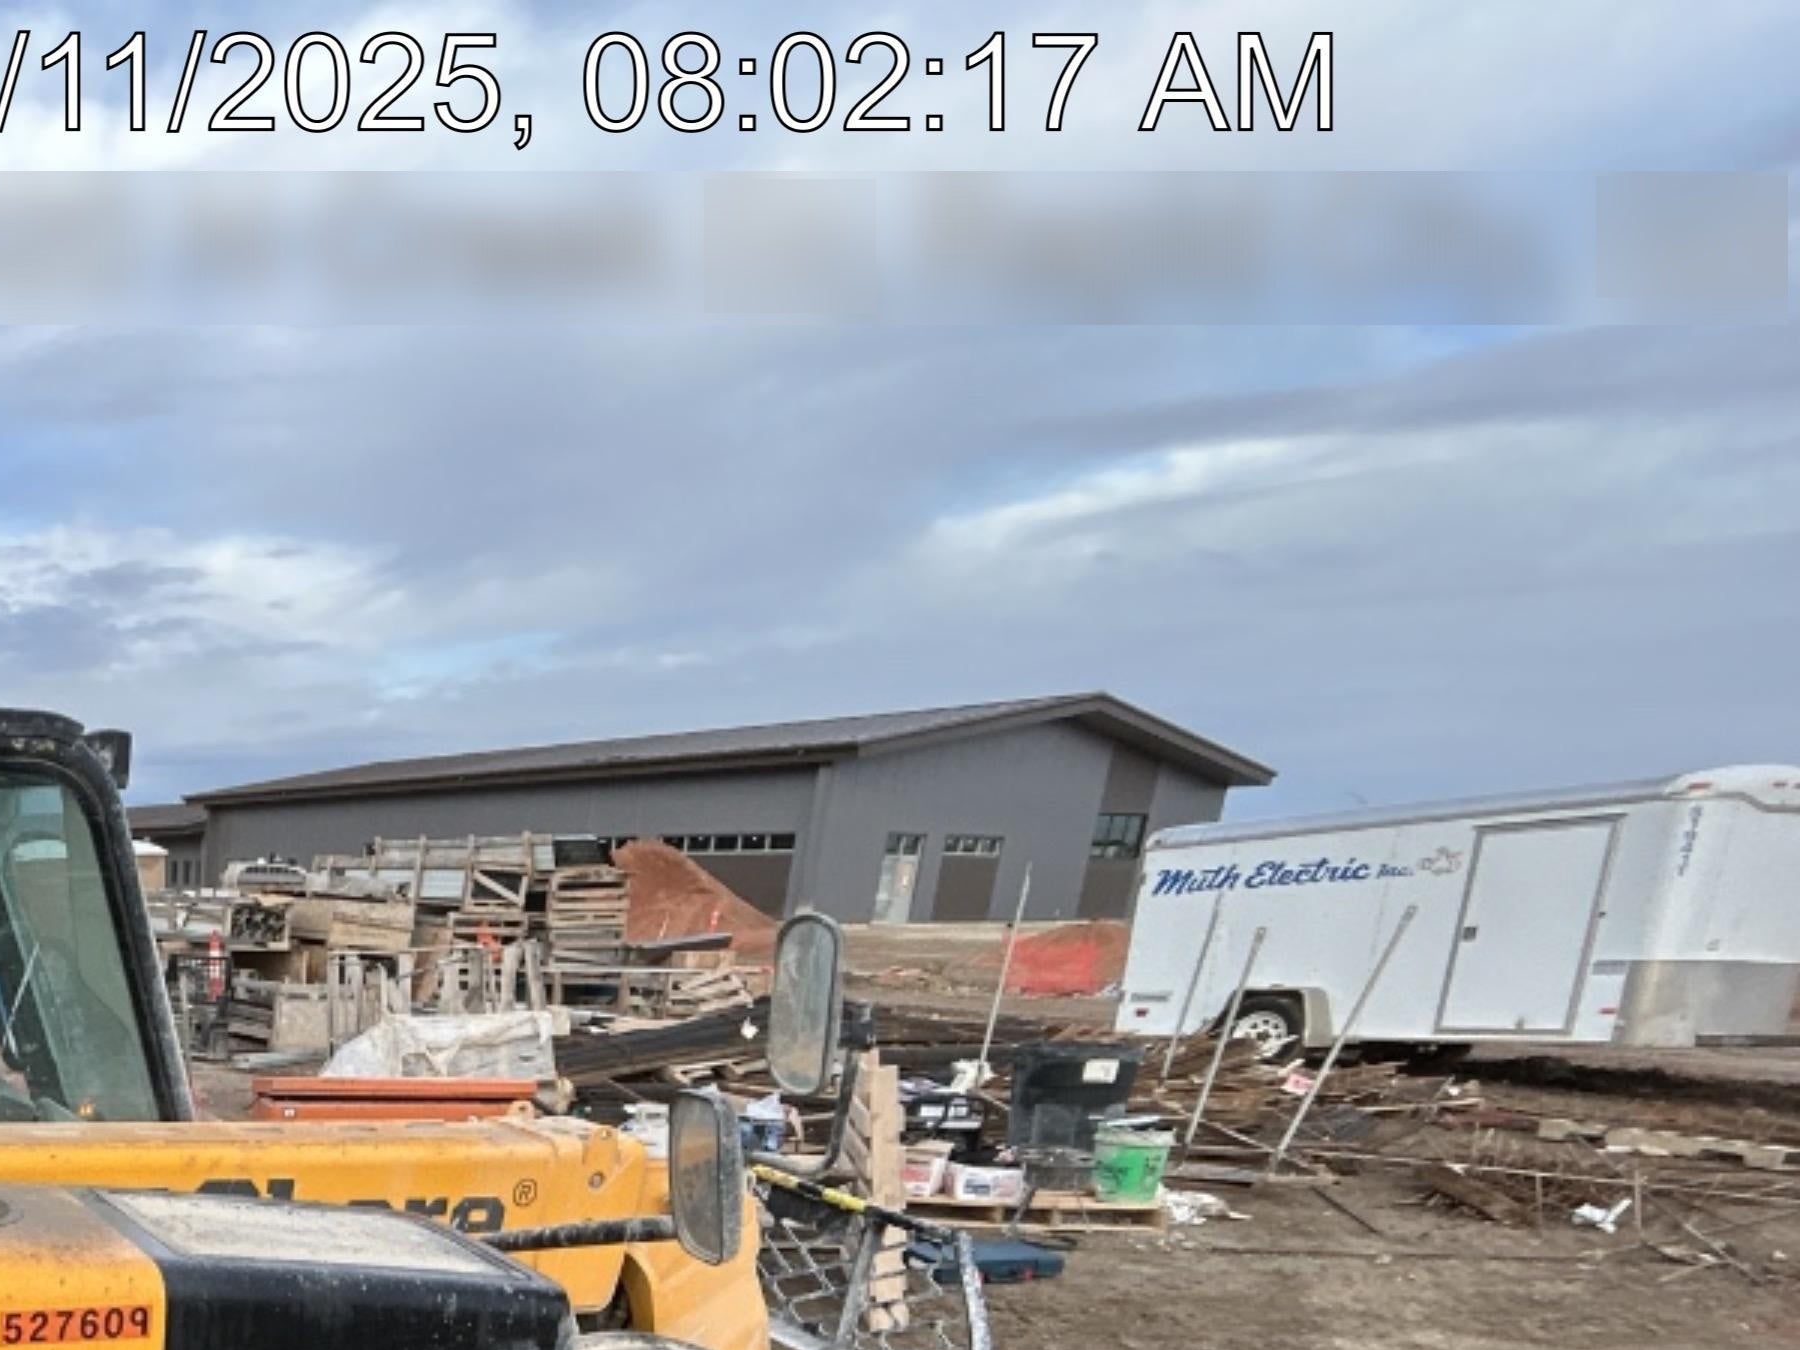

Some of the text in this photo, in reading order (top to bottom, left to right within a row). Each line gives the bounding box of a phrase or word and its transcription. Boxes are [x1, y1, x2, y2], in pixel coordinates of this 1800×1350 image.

[1151, 862, 1241, 897] Muth
[1244, 857, 1372, 889] Electric
[3, 1306, 149, 1345] 527609
